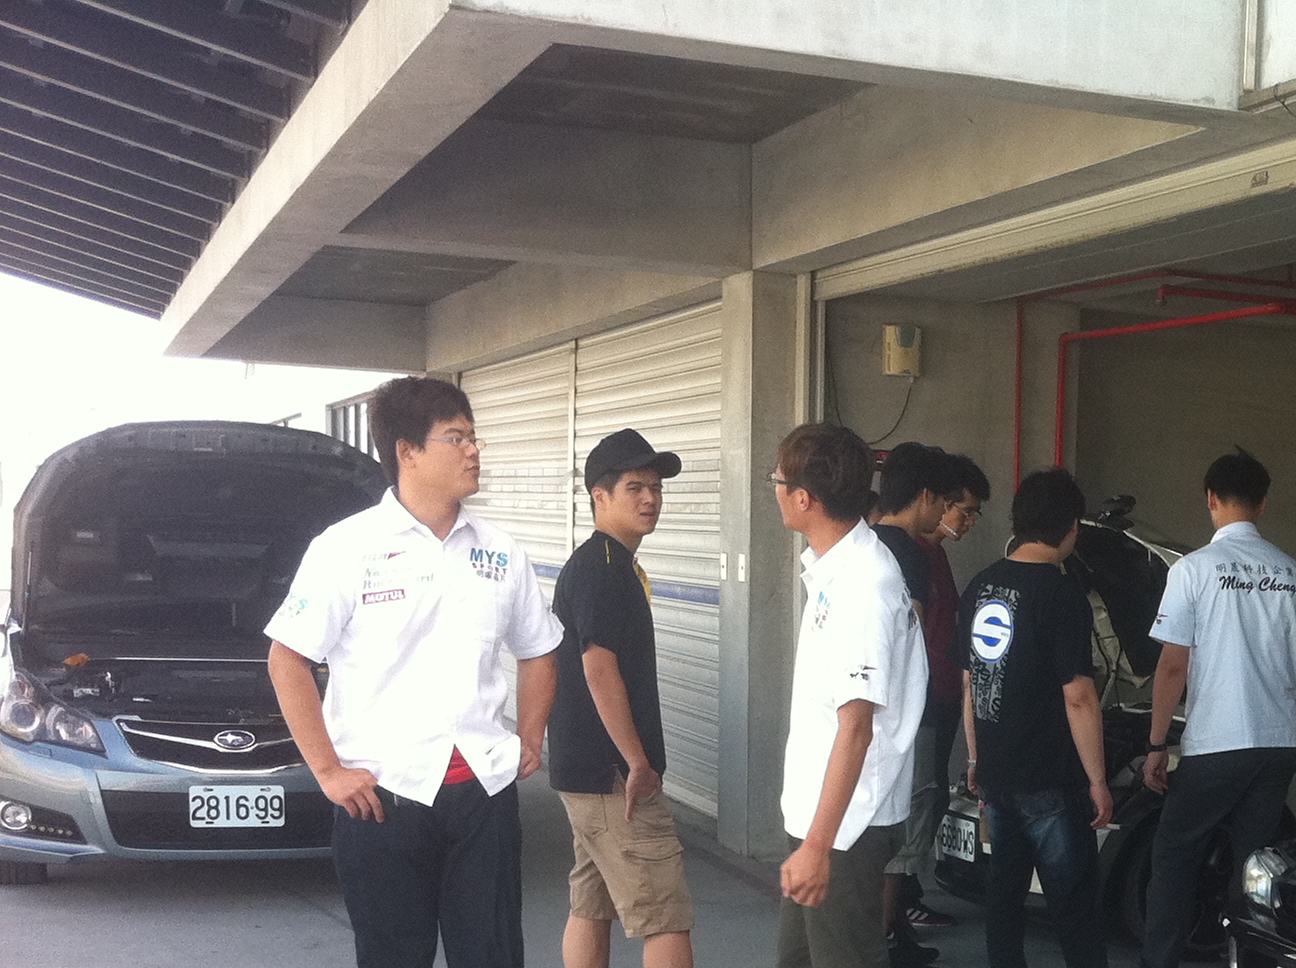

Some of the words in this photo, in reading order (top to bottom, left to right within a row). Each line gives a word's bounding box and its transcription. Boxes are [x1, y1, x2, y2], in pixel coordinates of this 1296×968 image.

[470, 547, 508, 567] MYS
[364, 590, 405, 604] MOTUL
[1219, 575, 1255, 594] Ming
[1258, 576, 1296, 598] Cheng
[191, 795, 284, 821] 2816-99
